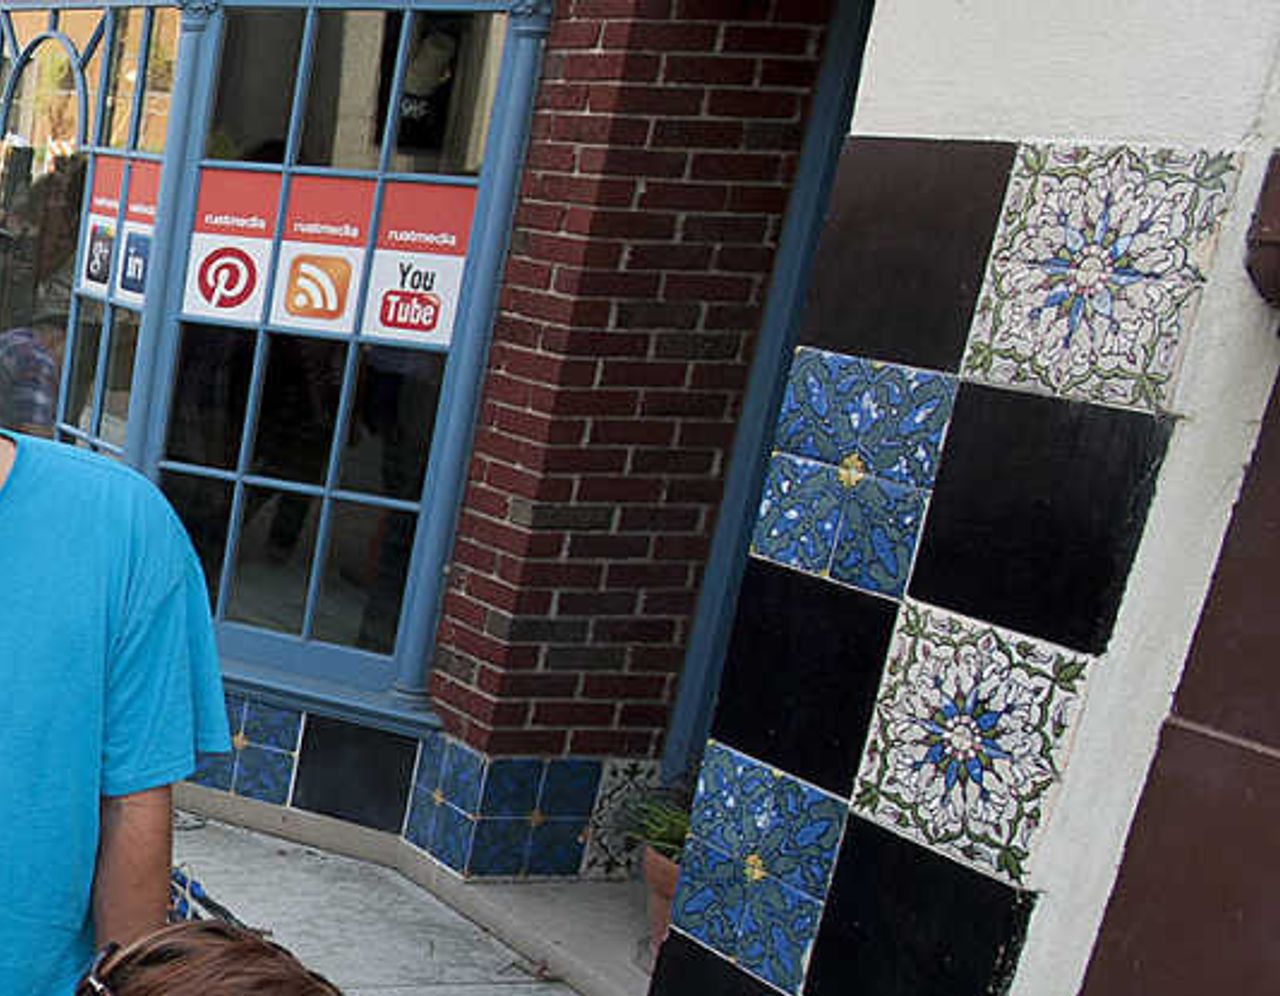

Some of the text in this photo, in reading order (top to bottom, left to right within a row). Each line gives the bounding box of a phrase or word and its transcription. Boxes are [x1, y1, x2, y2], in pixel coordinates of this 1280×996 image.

[387, 229, 456, 246] rustmedia
[398, 261, 436, 292] You
[386, 295, 435, 326] Tube
